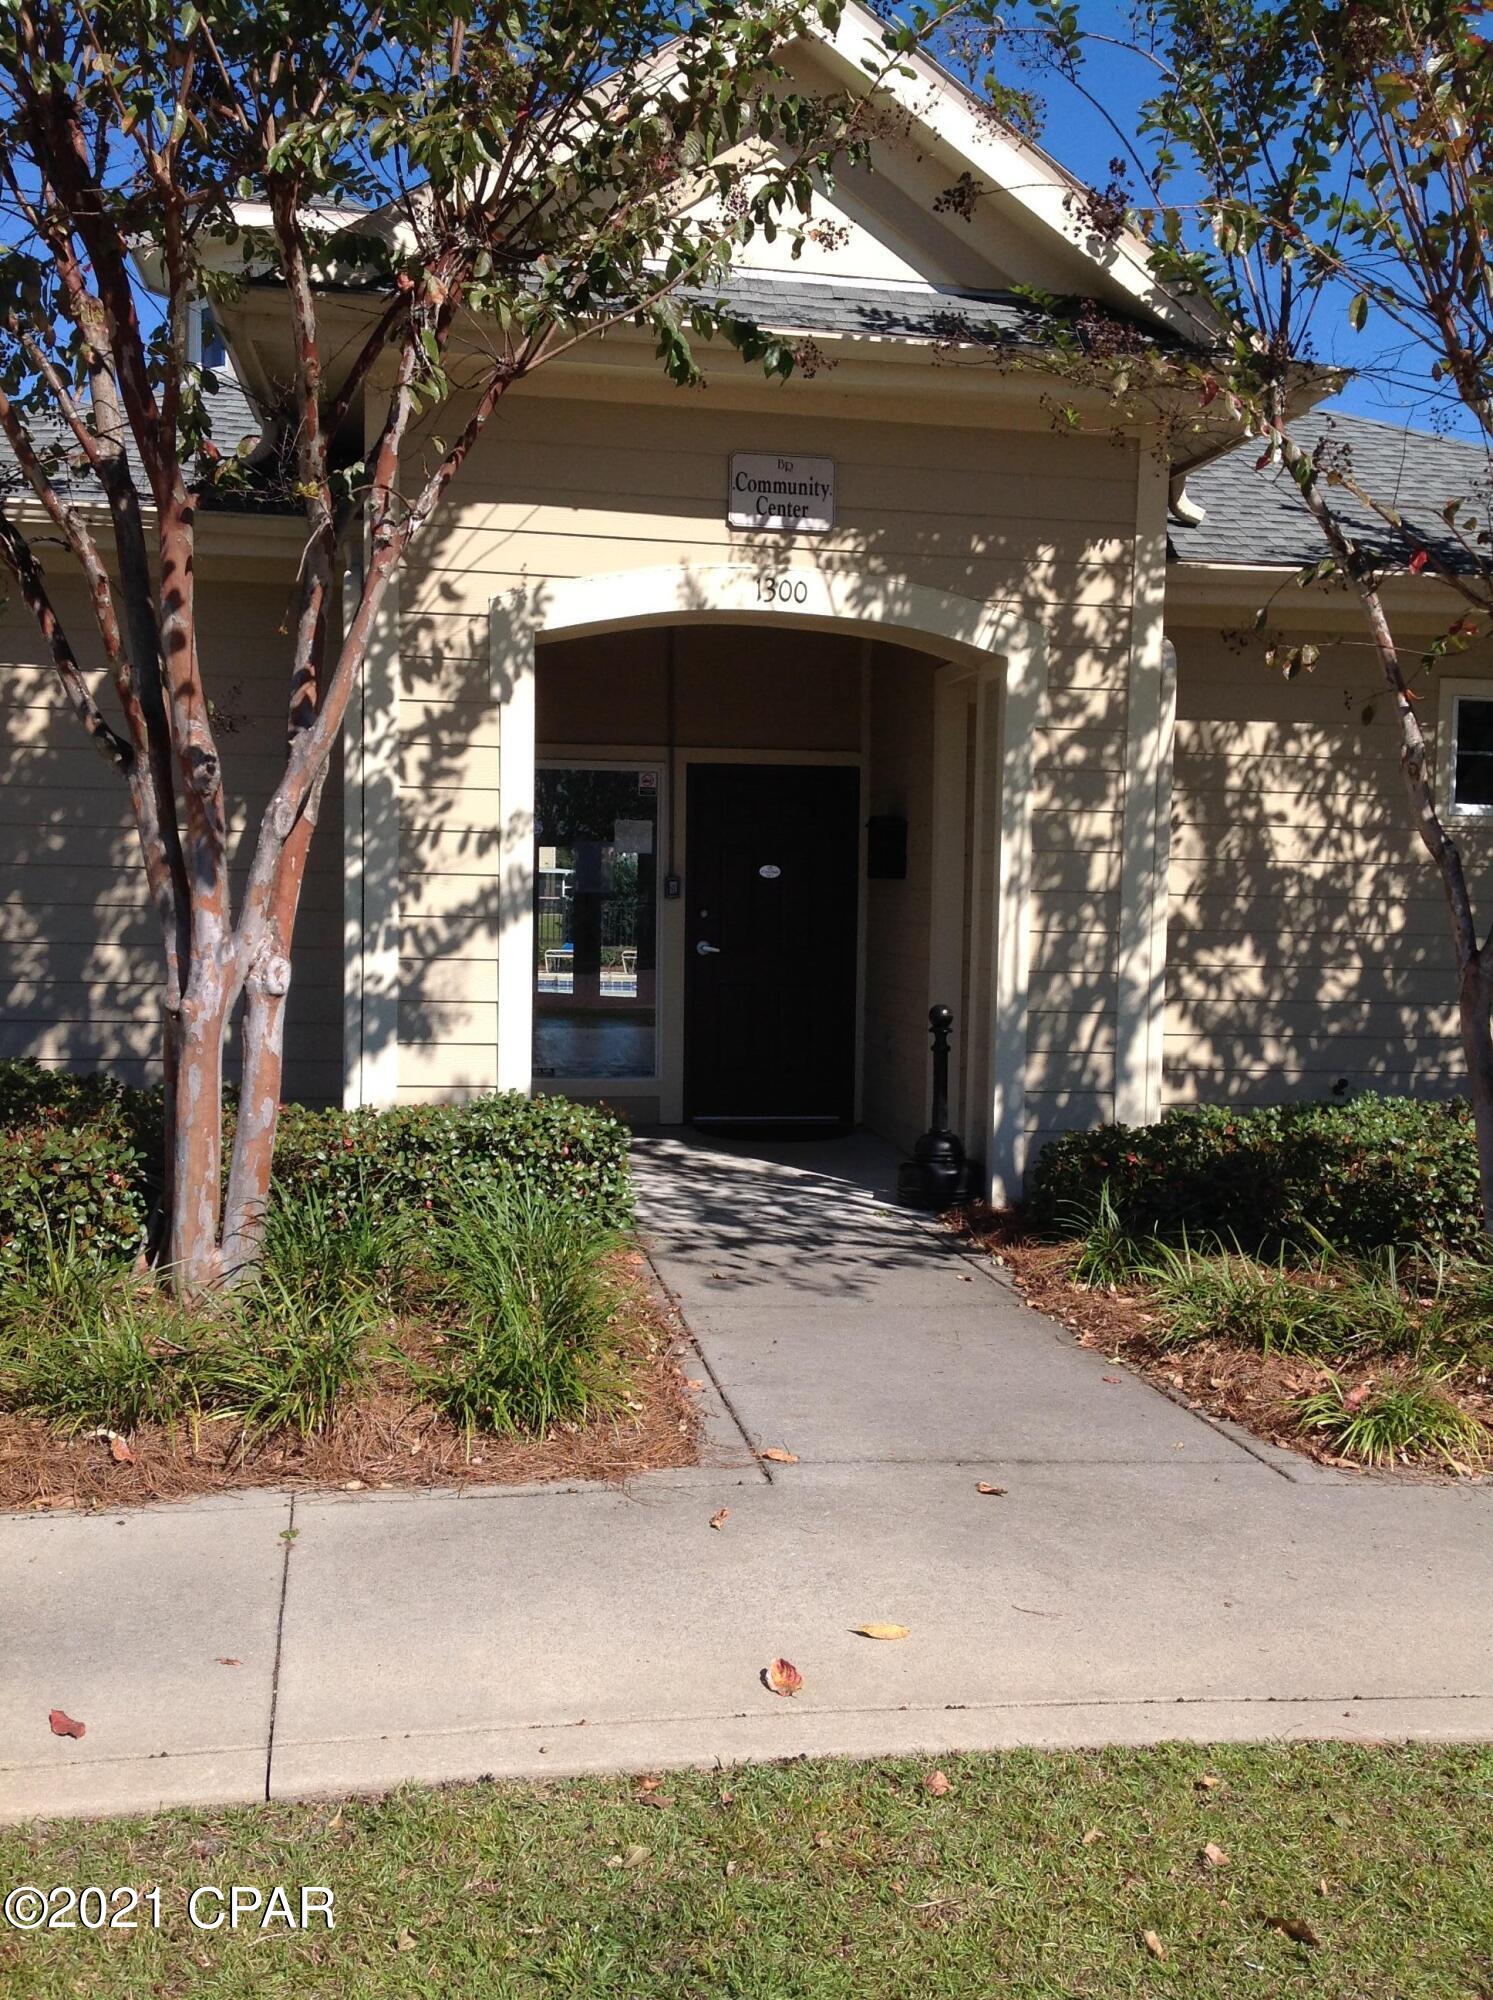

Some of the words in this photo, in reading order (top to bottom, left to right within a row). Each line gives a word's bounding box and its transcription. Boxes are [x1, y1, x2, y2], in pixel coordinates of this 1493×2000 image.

[735, 471, 830, 502] Community
[756, 496, 809, 518] Center
[756, 577, 808, 604] 1300
